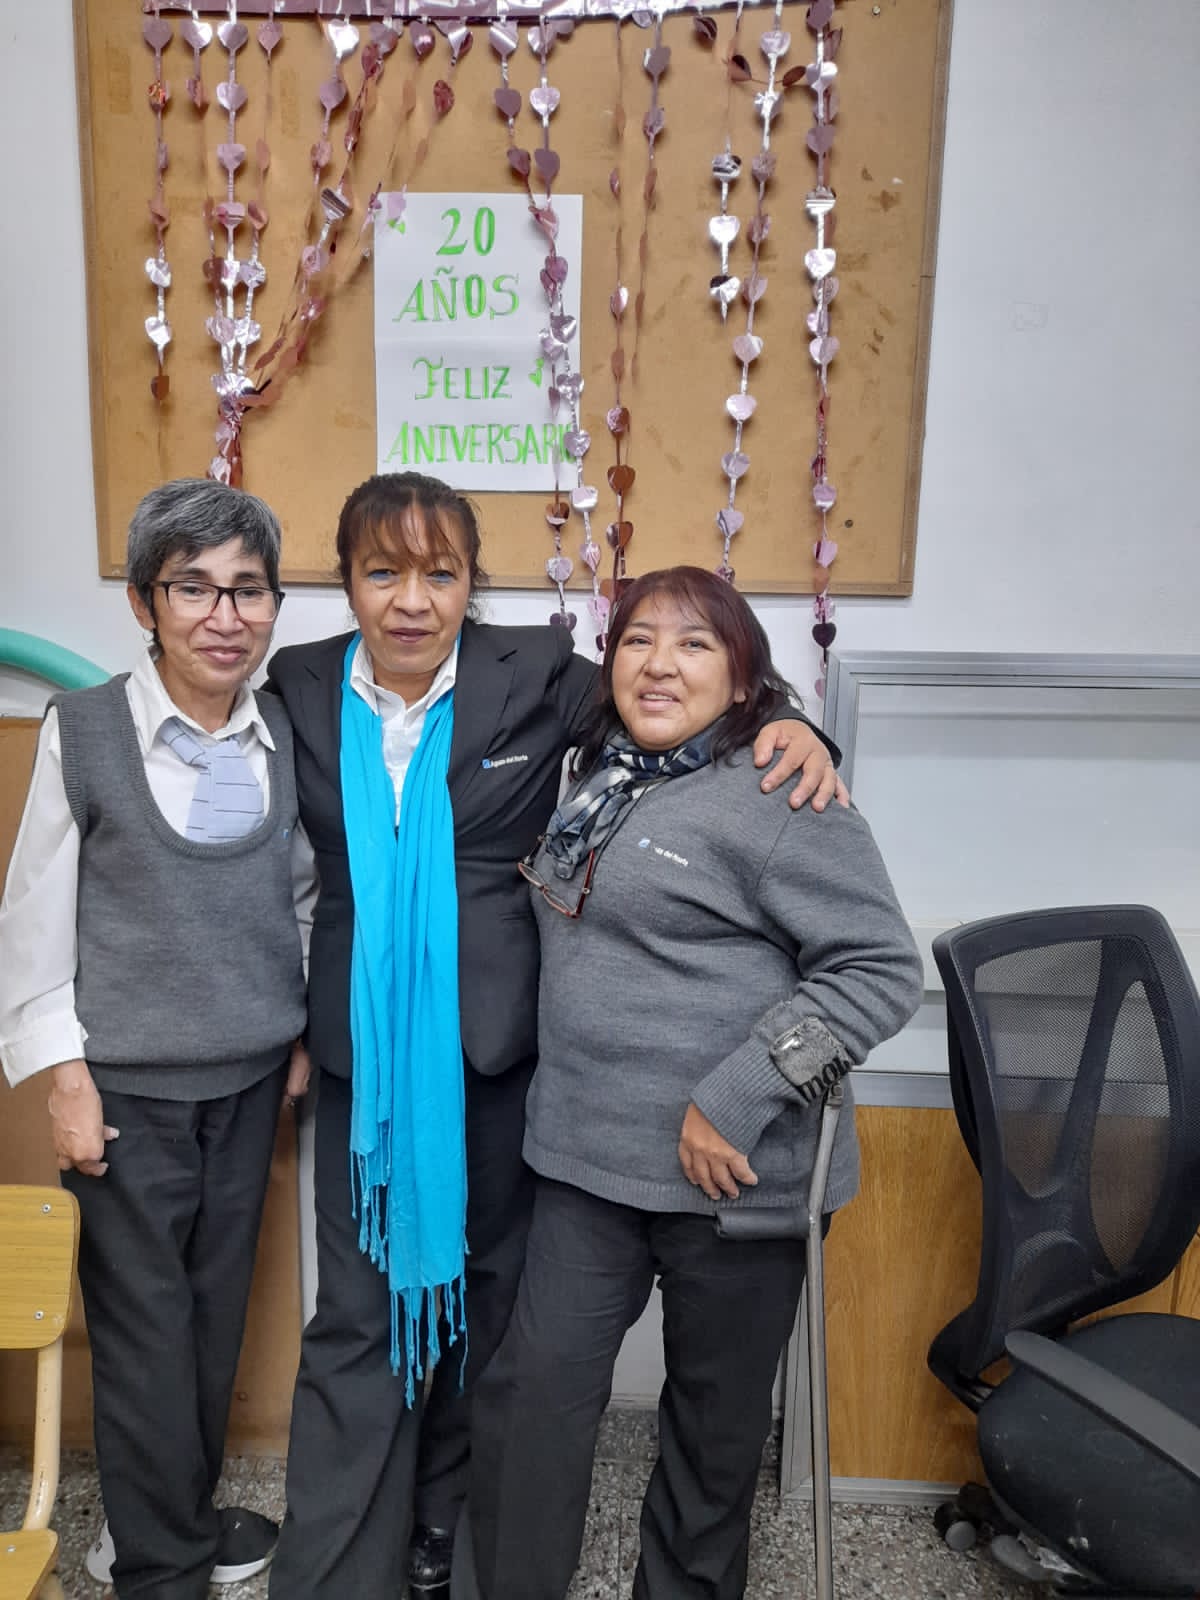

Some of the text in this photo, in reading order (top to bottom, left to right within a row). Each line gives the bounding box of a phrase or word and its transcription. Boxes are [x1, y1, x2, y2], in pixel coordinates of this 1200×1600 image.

[436, 206, 496, 256] 20
[392, 265, 520, 322] AÑOS
[412, 355, 513, 400] FELIZ
